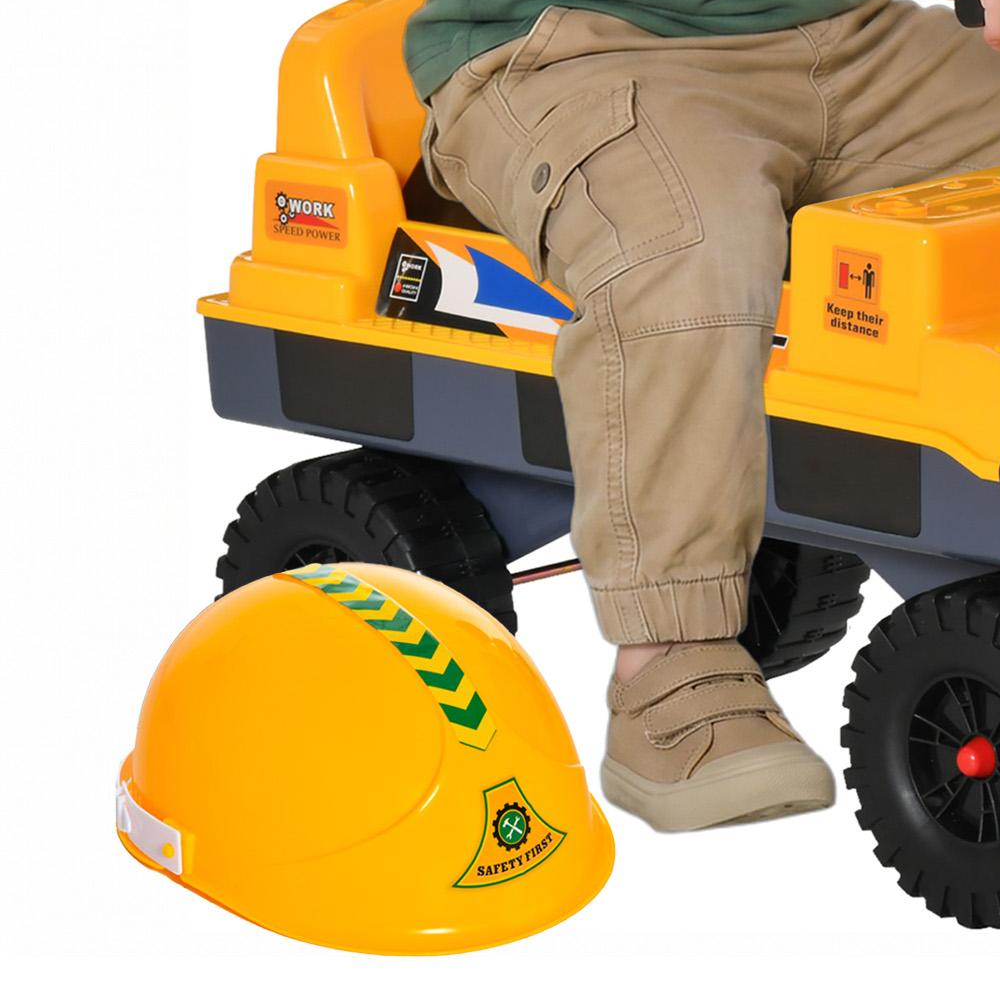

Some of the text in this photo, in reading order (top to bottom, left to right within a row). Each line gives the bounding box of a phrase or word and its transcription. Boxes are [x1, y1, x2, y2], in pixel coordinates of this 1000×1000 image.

[288, 198, 335, 218] WORK
[273, 224, 341, 242] SPEED POWER
[826, 302, 884, 326] Keep their
[830, 317, 879, 338] distance
[477, 832, 554, 877] SAFETY FIRST
